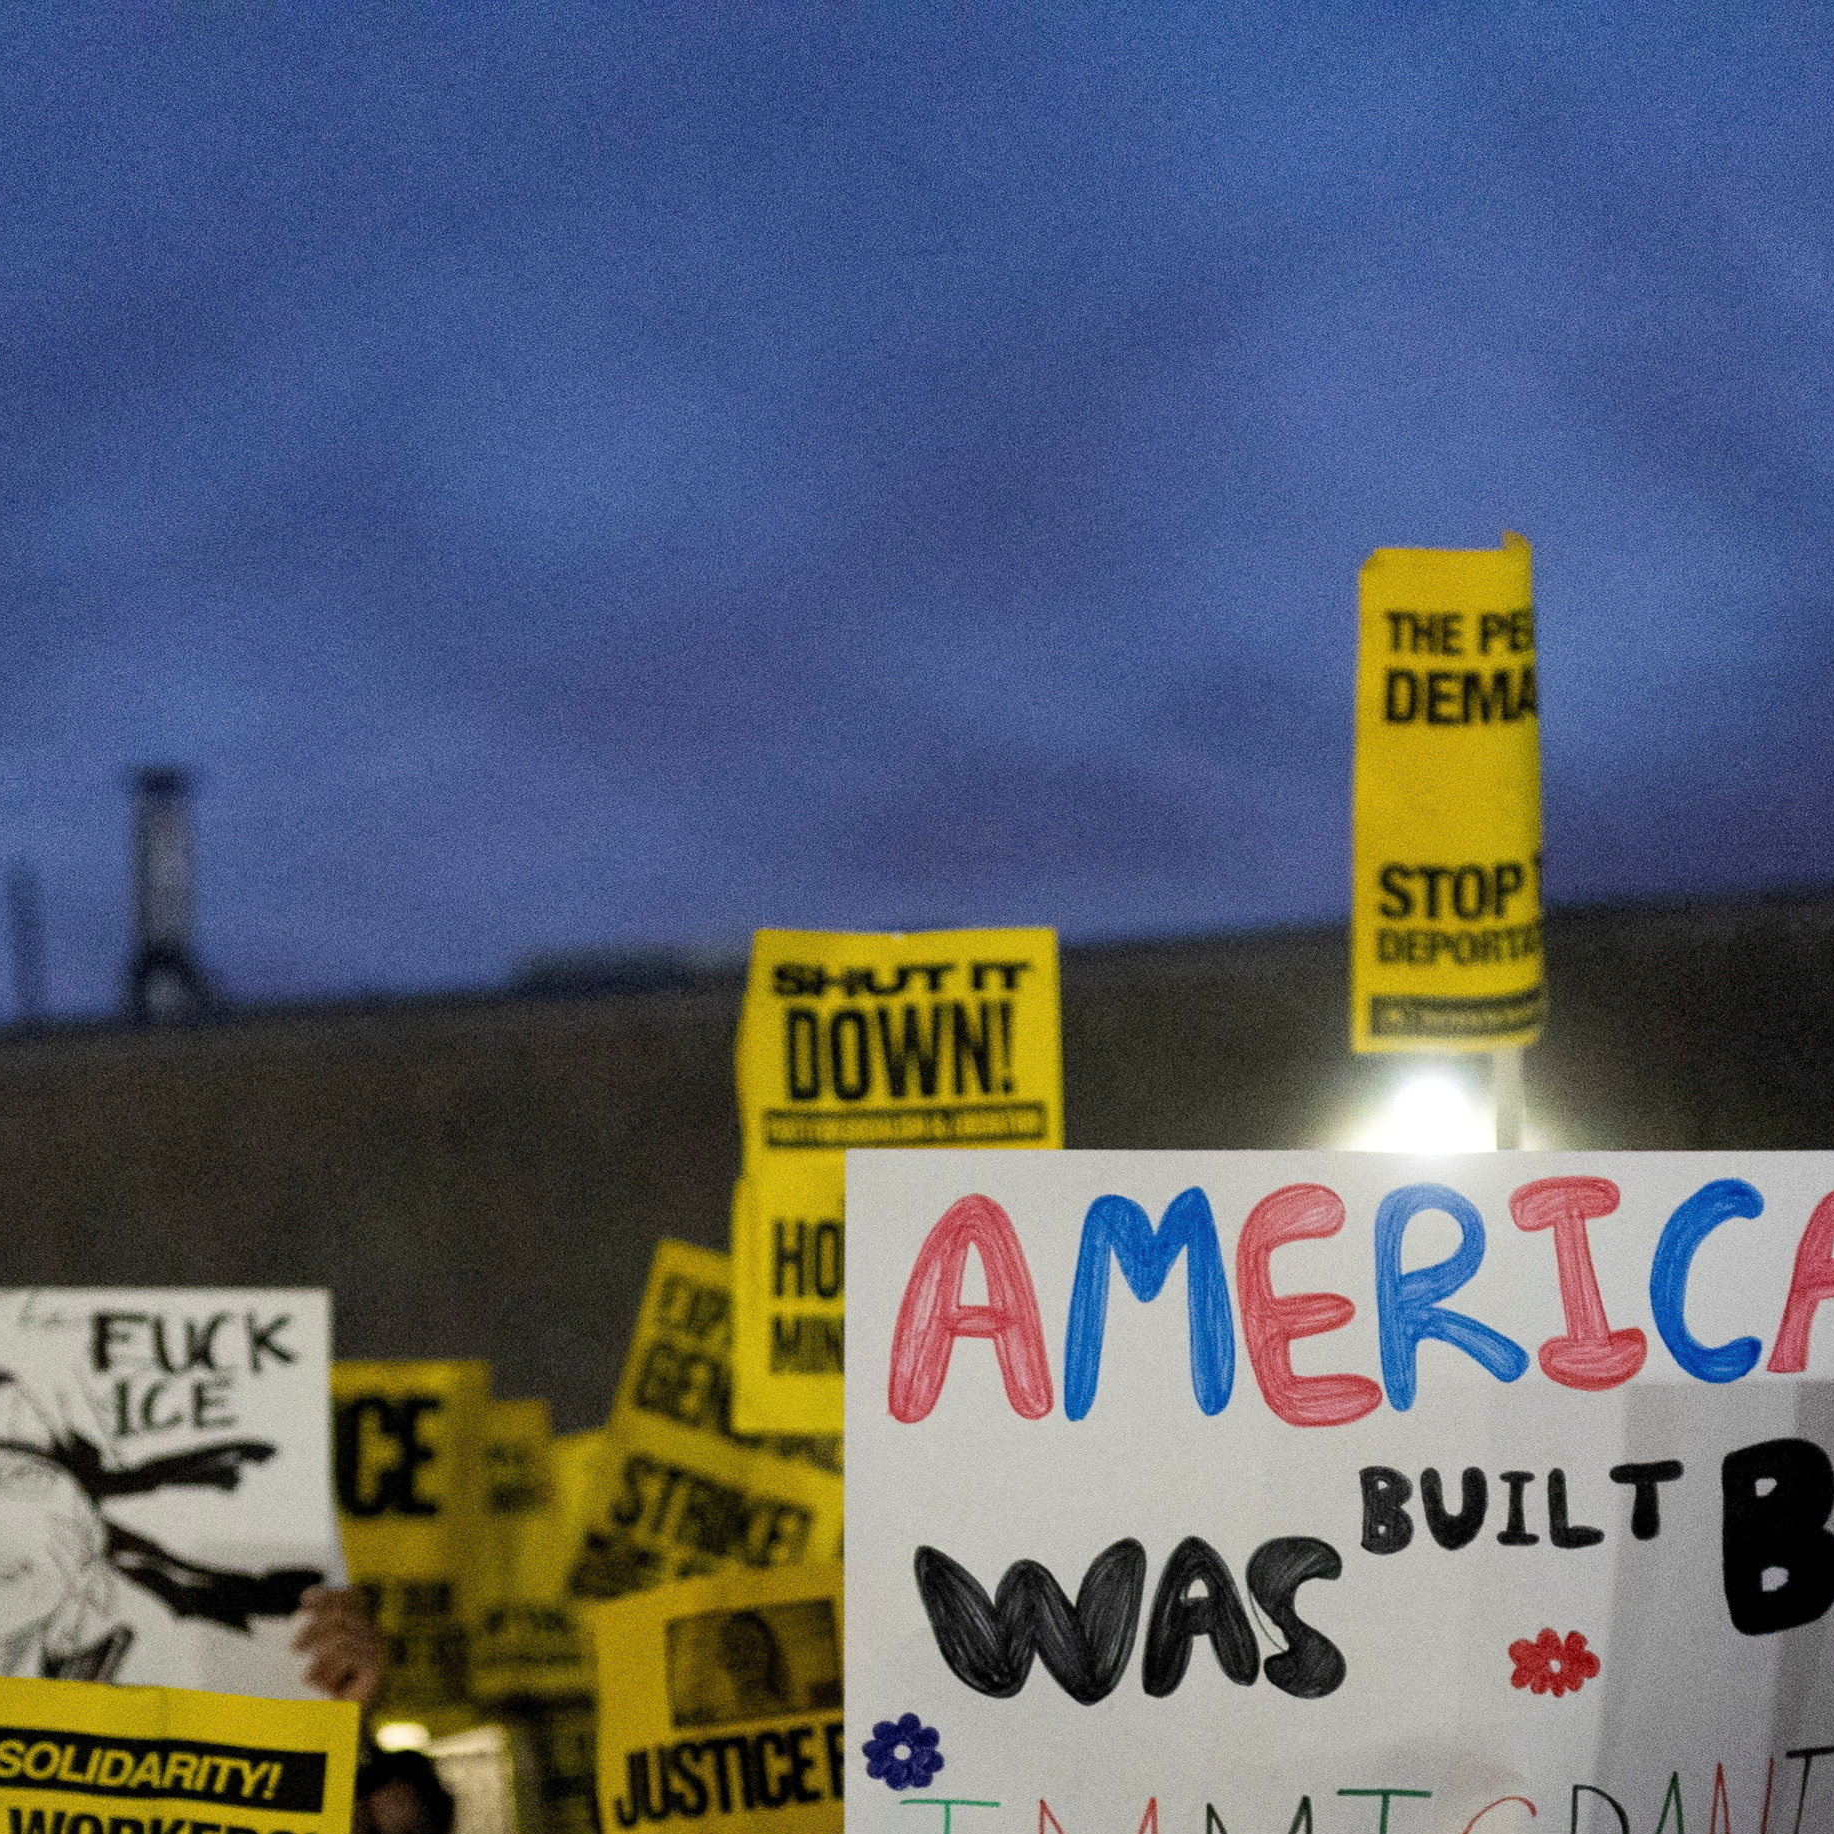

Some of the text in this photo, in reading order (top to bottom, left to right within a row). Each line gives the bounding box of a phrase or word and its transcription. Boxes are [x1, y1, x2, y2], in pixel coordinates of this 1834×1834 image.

[1384, 609, 1536, 657] THE PE
[1377, 861, 1525, 921] STOP
[773, 959, 1032, 998] SHUT IT
[786, 1000, 1015, 1101] DOWN!
[88, 1310, 301, 1376] FUCK
[111, 1376, 242, 1438] ICE
[334, 1393, 443, 1518] CE
[913, 1535, 1347, 1705] WAS
[1359, 1457, 1684, 1555] BUILT
[616, 1728, 821, 1828] JUSTICE
